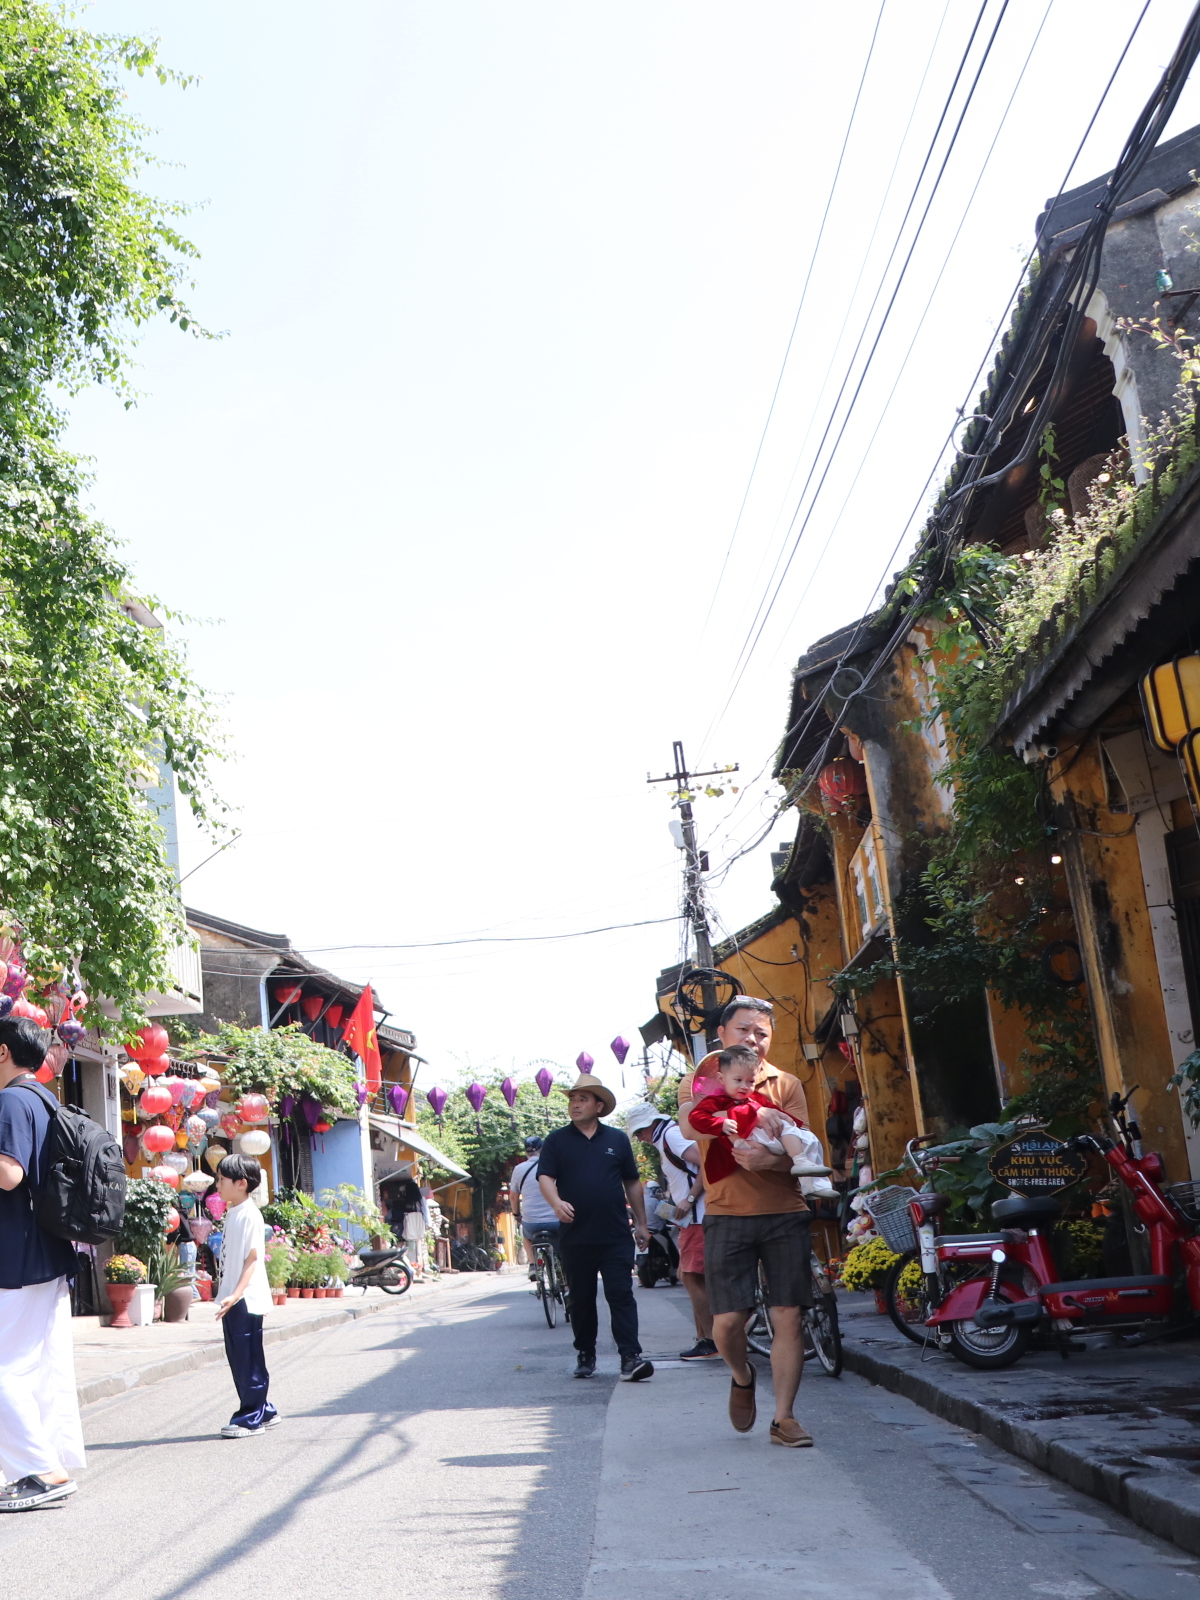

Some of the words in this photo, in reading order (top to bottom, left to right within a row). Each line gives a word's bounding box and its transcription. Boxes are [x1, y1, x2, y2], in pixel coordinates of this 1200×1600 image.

[1011, 1156, 1035, 1165] KHU
[998, 1165, 1018, 1176] CẤM
[1048, 1178, 1065, 1186] AREA
[8, 1498, 35, 1508] crocs
